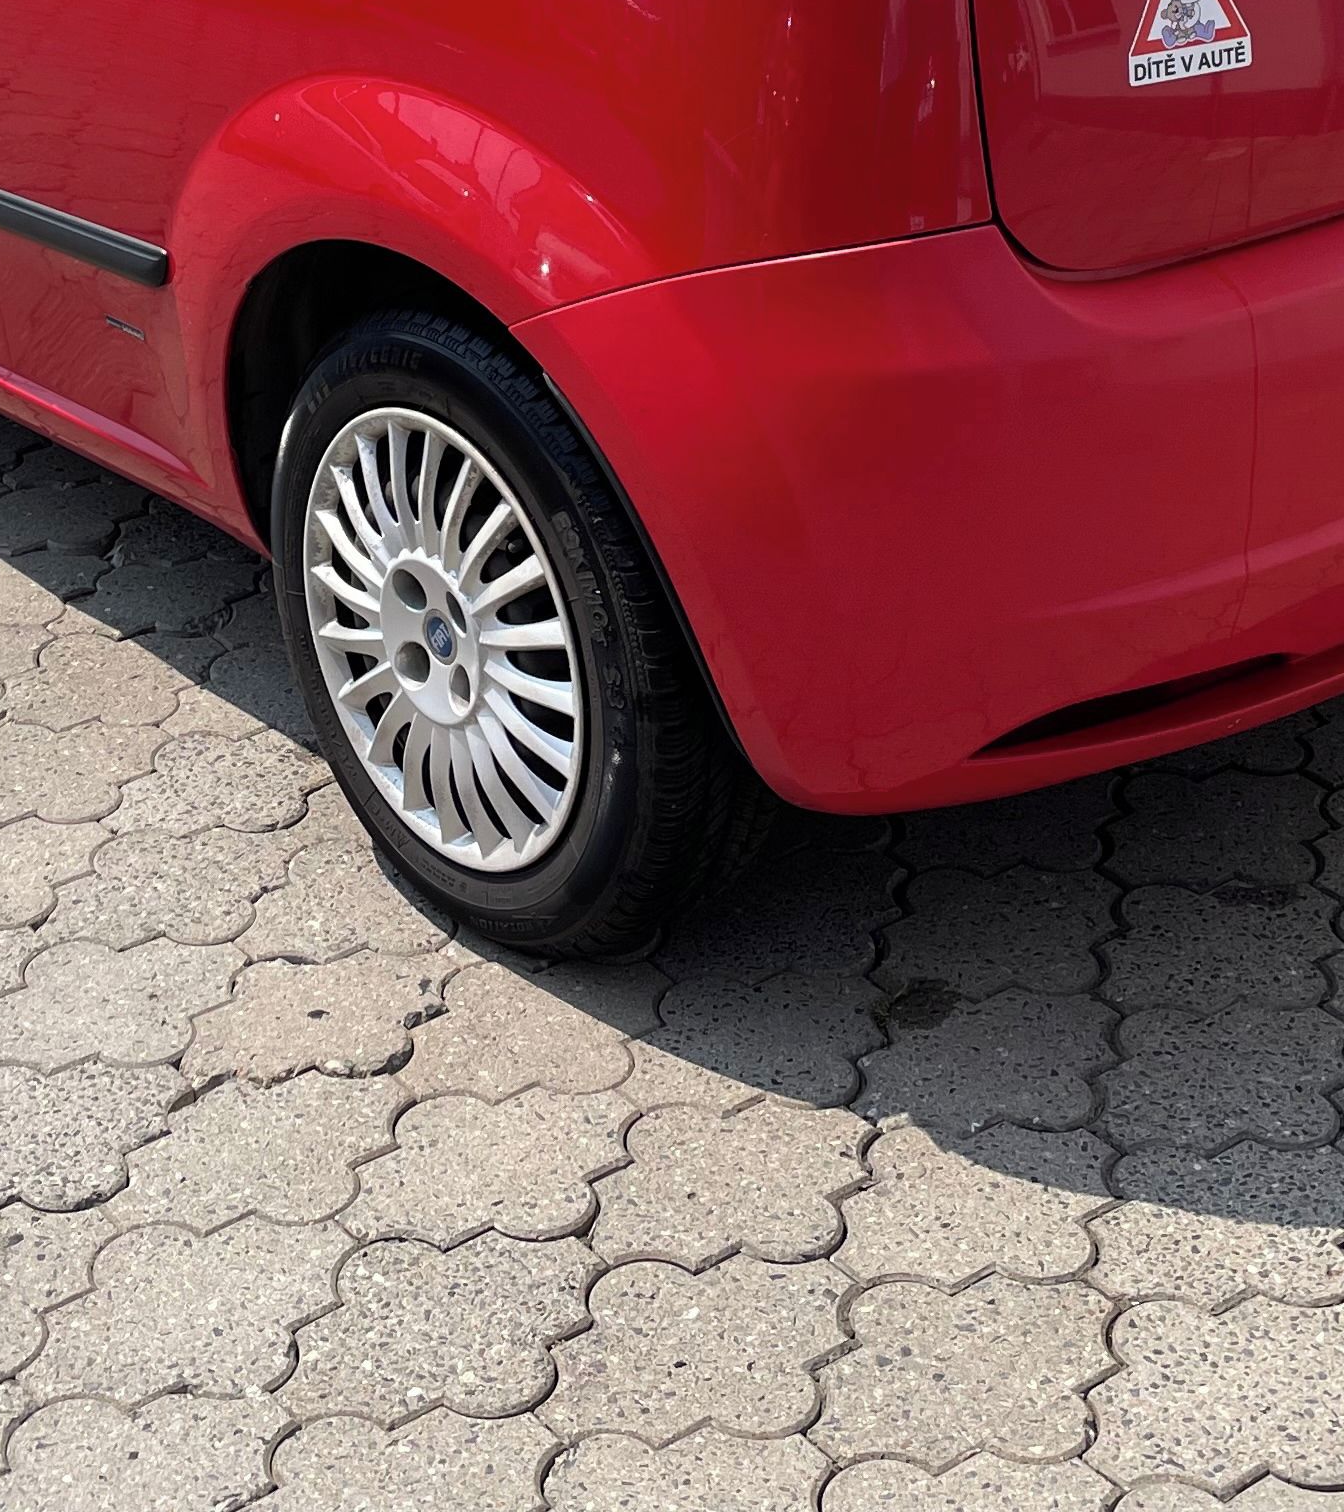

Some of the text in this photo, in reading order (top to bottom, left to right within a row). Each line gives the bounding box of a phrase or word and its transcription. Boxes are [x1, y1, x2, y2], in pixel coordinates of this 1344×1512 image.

[1134, 40, 1246, 82] DÍTĚ V AUTĚ
